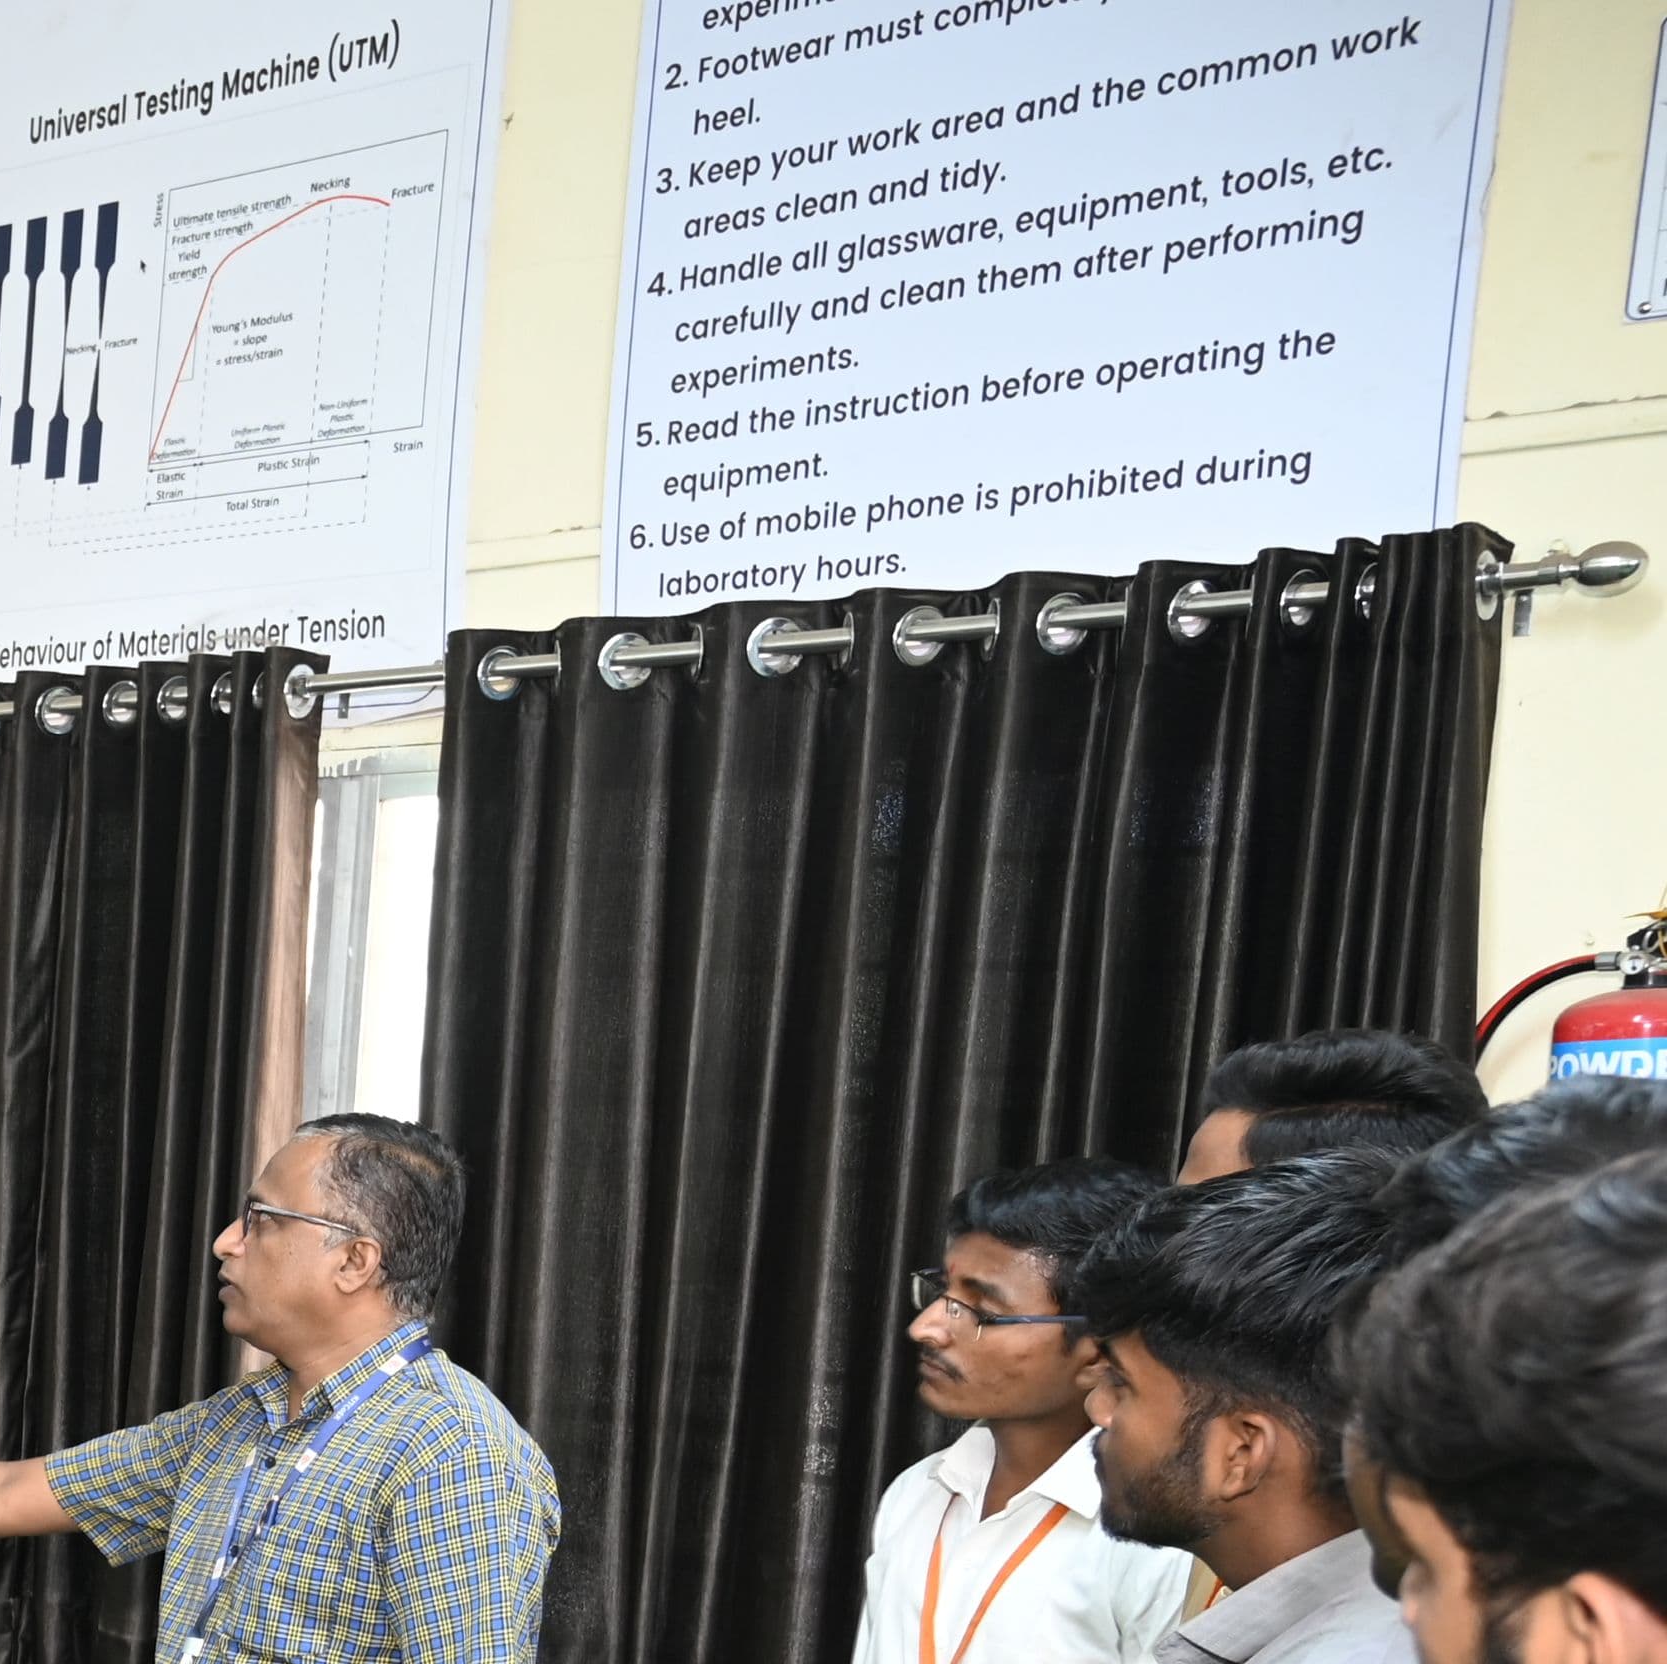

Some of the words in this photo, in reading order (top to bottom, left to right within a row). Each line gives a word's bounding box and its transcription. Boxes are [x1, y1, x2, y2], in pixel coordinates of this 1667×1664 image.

[664, 64, 689, 90] 2.
[698, 31, 835, 83] Footwear
[844, 10, 923, 52] must
[29, 94, 127, 145] Universal
[135, 79, 214, 121] Testing
[222, 52, 320, 101] Machine
[328, 18, 400, 82] (UTM)
[655, 168, 680, 195] 3.
[689, 155, 761, 188] Keep
[770, 137, 838, 180] your
[847, 118, 921, 156] work
[931, 107, 1004, 141] area
[1015, 85, 1081, 124] and
[1091, 67, 1146, 109] the
[1157, 42, 1318, 96] common
[1331, 16, 1421, 61] work
[692, 98, 761, 135] heel.
[310, 176, 351, 193] Necking
[391, 182, 435, 200] Fracture
[684, 205, 765, 240] areas
[775, 183, 857, 224] clean
[868, 169, 929, 206] and
[940, 158, 1007, 194] tidy.
[153, 192, 165, 229] Stress
[173, 211, 214, 229] Ultimate
[216, 204, 249, 221] tensile
[251, 194, 292, 213] strength
[646, 272, 673, 298] 4.
[680, 254, 783, 292] Handle
[791, 241, 828, 272] all
[836, 217, 1005, 274] glassware,
[1014, 176, 1207, 239] equipment,
[1221, 157, 1314, 197] tools,
[1327, 146, 1392, 179] etc.
[171, 230, 211, 246] Fracture
[213, 220, 254, 238] strength
[168, 265, 208, 282] strength
[177, 249, 201, 263] Yield
[674, 301, 801, 343] carefully
[811, 287, 870, 322] and
[879, 274, 965, 310] clean
[977, 258, 1062, 295] them
[1073, 244, 1153, 279] after
[1163, 209, 1364, 274] performing
[212, 319, 248, 336] Young's
[250, 312, 294, 329] Modulus
[242, 333, 268, 348] slope
[635, 422, 661, 448] 5.
[667, 411, 738, 446] Read
[748, 406, 796, 434] the
[805, 381, 969, 428] instruction
[981, 368, 1085, 402] before
[1095, 341, 1265, 394] operating
[1279, 330, 1337, 361] the
[670, 346, 860, 399] experiments.
[257, 460, 289, 473] Plastic
[291, 454, 320, 468] Strain
[393, 440, 424, 454] Strain
[156, 472, 186, 485] Elastic
[156, 489, 183, 501] Strain
[663, 453, 828, 502] equipment.
[226, 500, 249, 512] Total
[251, 496, 280, 510] Strain
[629, 523, 655, 549] 6.
[660, 521, 711, 547] Use
[719, 512, 747, 541] of
[755, 501, 856, 538] mobile
[865, 488, 964, 532] phone
[975, 483, 1000, 511] is
[1010, 460, 1184, 517] prohibited
[1195, 449, 1312, 485] during
[659, 559, 806, 598] laboratory
[816, 553, 907, 582] hours.
[93, 629, 113, 661] of
[118, 623, 217, 660] Materials
[297, 608, 386, 645] Tension
